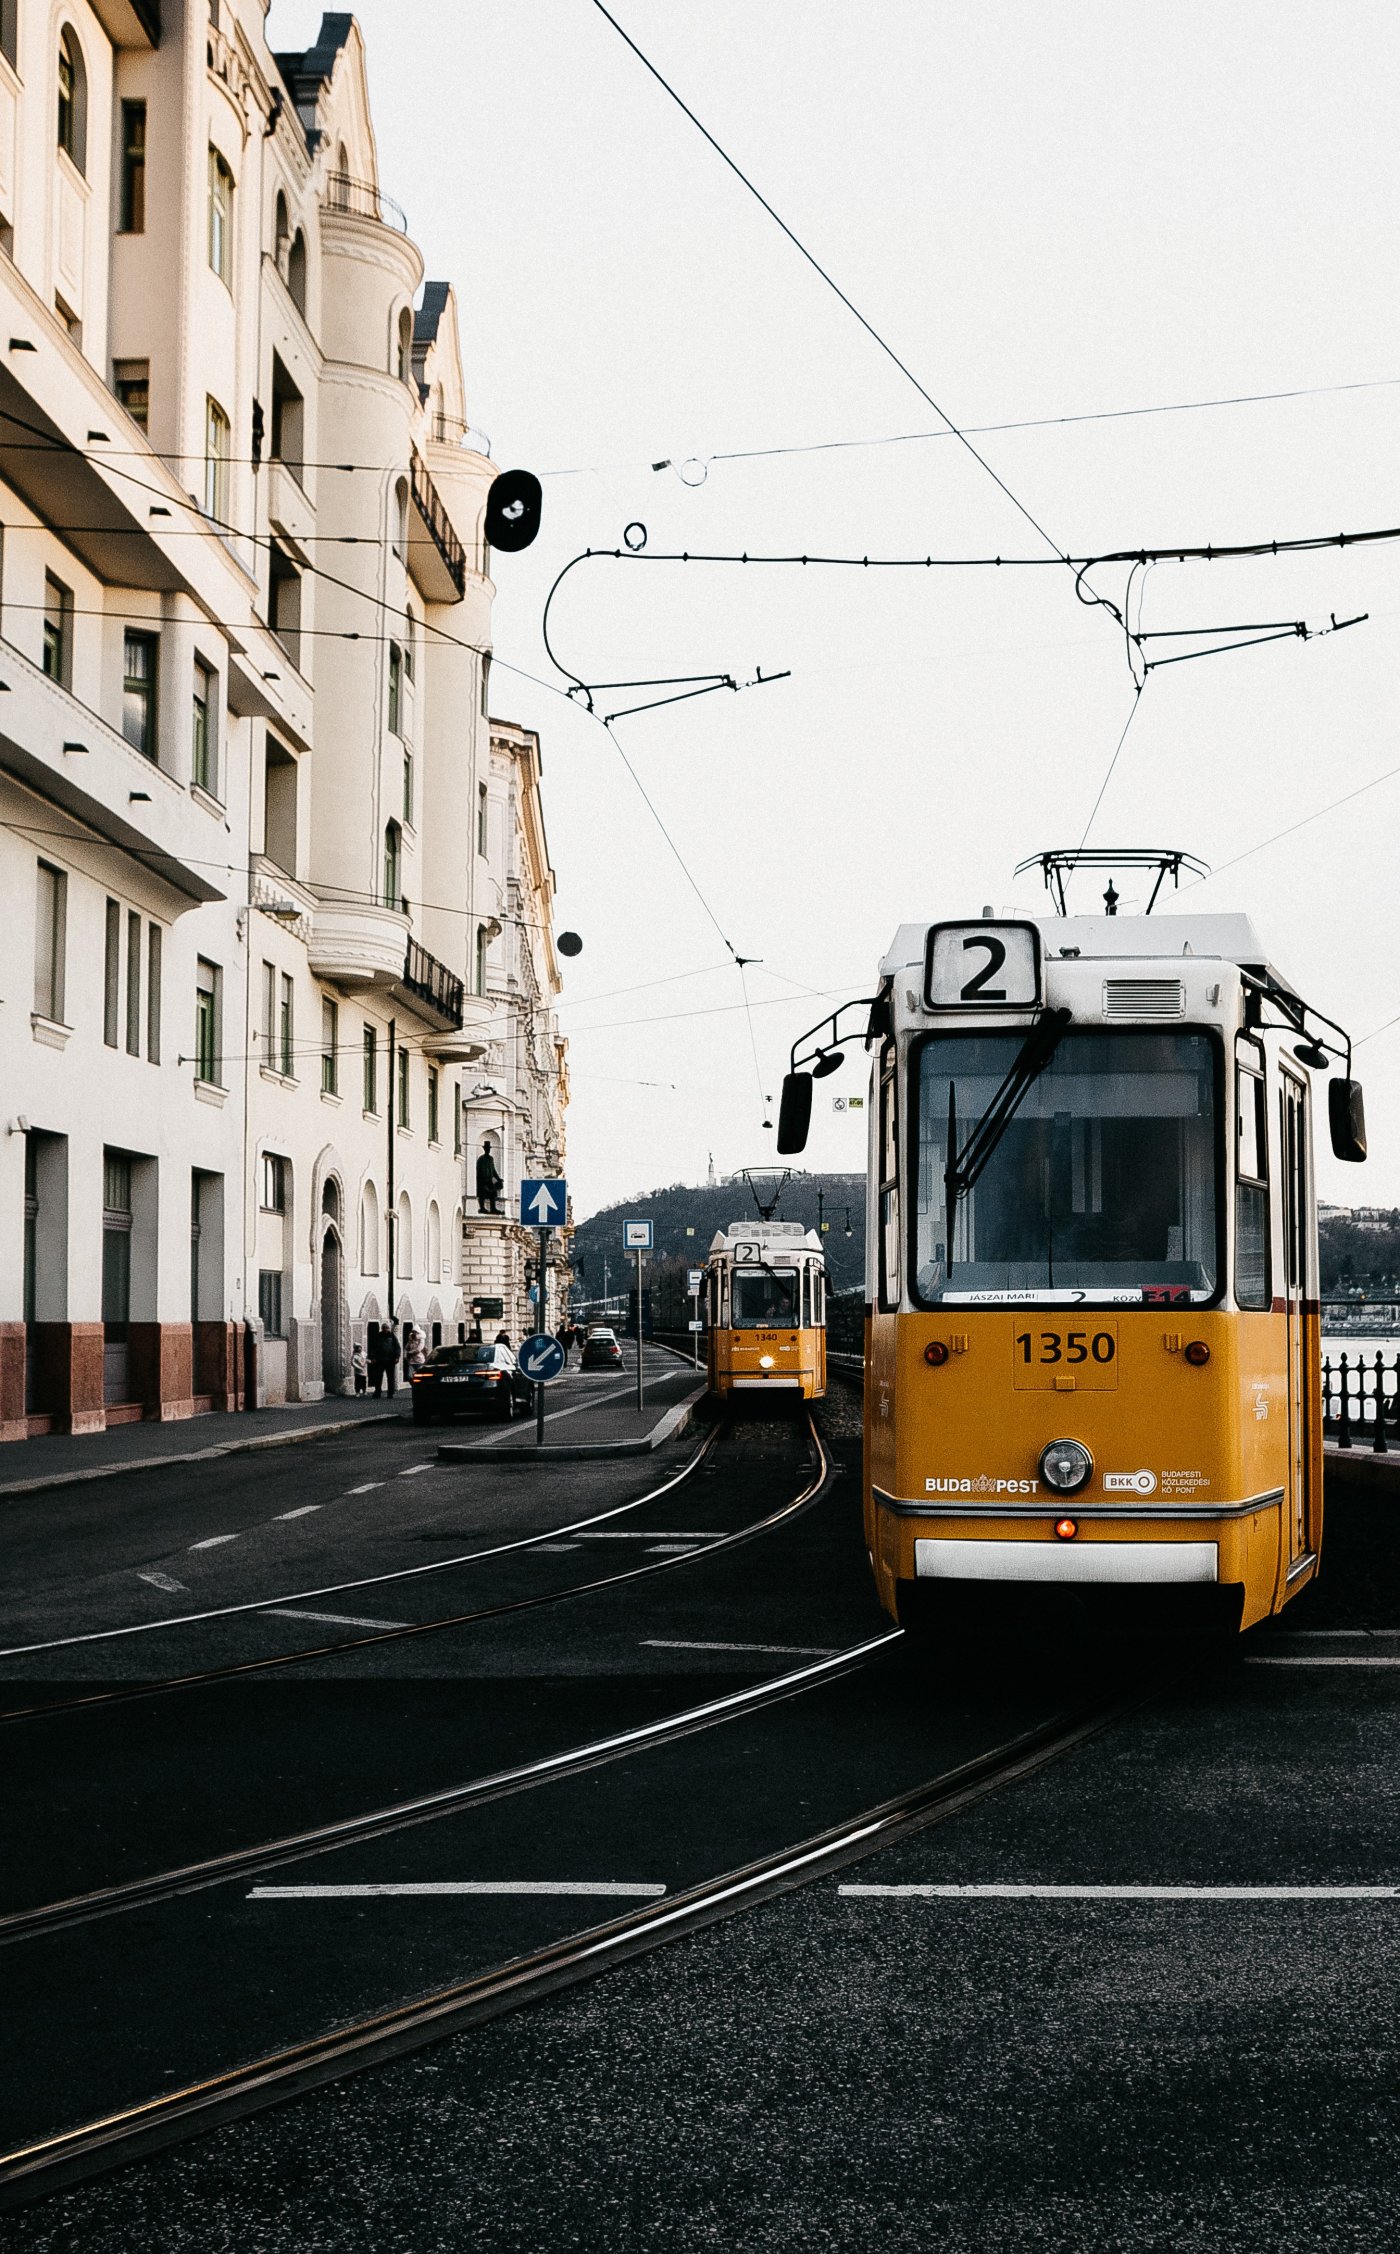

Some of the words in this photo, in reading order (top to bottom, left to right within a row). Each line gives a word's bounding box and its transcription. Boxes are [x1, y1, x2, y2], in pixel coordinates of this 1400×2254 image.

[960, 937, 1007, 1000] 2
[742, 1246, 753, 1261] 2
[1071, 1291, 1087, 1302] 2
[755, 1333, 777, 1341] 1340
[1016, 1332, 1116, 1364] 1350
[1110, 1477, 1133, 1486] BKK
